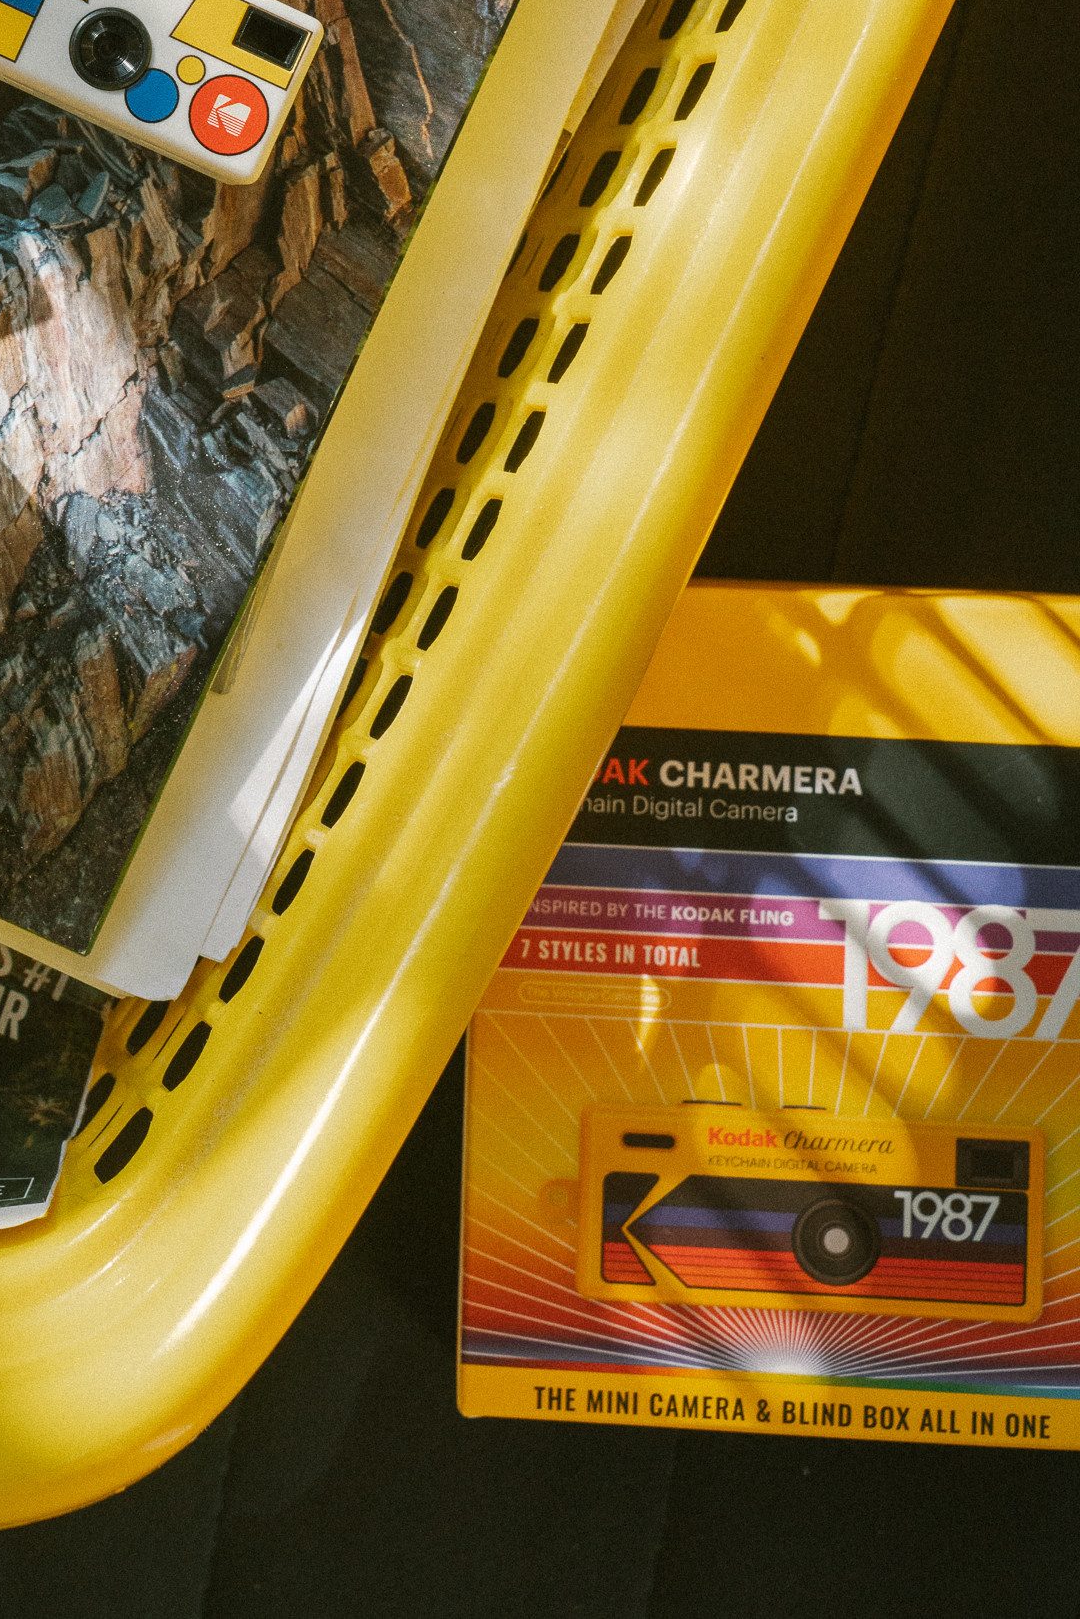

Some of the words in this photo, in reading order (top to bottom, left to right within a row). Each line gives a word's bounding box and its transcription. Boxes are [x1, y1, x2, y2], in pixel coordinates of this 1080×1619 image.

[659, 759, 864, 797] CHARMERA
[633, 795, 703, 821] Digital
[708, 797, 798, 823] Camera
[531, 899, 603, 917] NSPIRED
[606, 902, 629, 918] BY
[634, 903, 667, 920] THE
[670, 904, 735, 924] KODAK
[739, 907, 795, 927] FLING
[521, 938, 531, 959] 7
[538, 940, 607, 963] STYLES
[615, 943, 635, 965] IN
[642, 943, 701, 969] TOTAL
[818, 898, 1080, 1041] 1987
[707, 1126, 779, 1149] Kodak
[782, 1129, 895, 1156] Charmera
[707, 1155, 772, 1171] KEYCHAIN
[773, 1157, 822, 1173] DIGITAL
[824, 1160, 878, 1175] CAMERA
[893, 1189, 1001, 1243] 1987
[534, 1385, 577, 1412] THE
[586, 1389, 640, 1416] MINI
[649, 1392, 746, 1422] CAMERA
[755, 1397, 772, 1423] &
[781, 1399, 852, 1429] BLIND
[862, 1404, 910, 1432] BOX
[919, 1407, 961, 1435] ALL
[970, 1410, 995, 1436] IN
[1004, 1412, 1052, 1440] ONE
